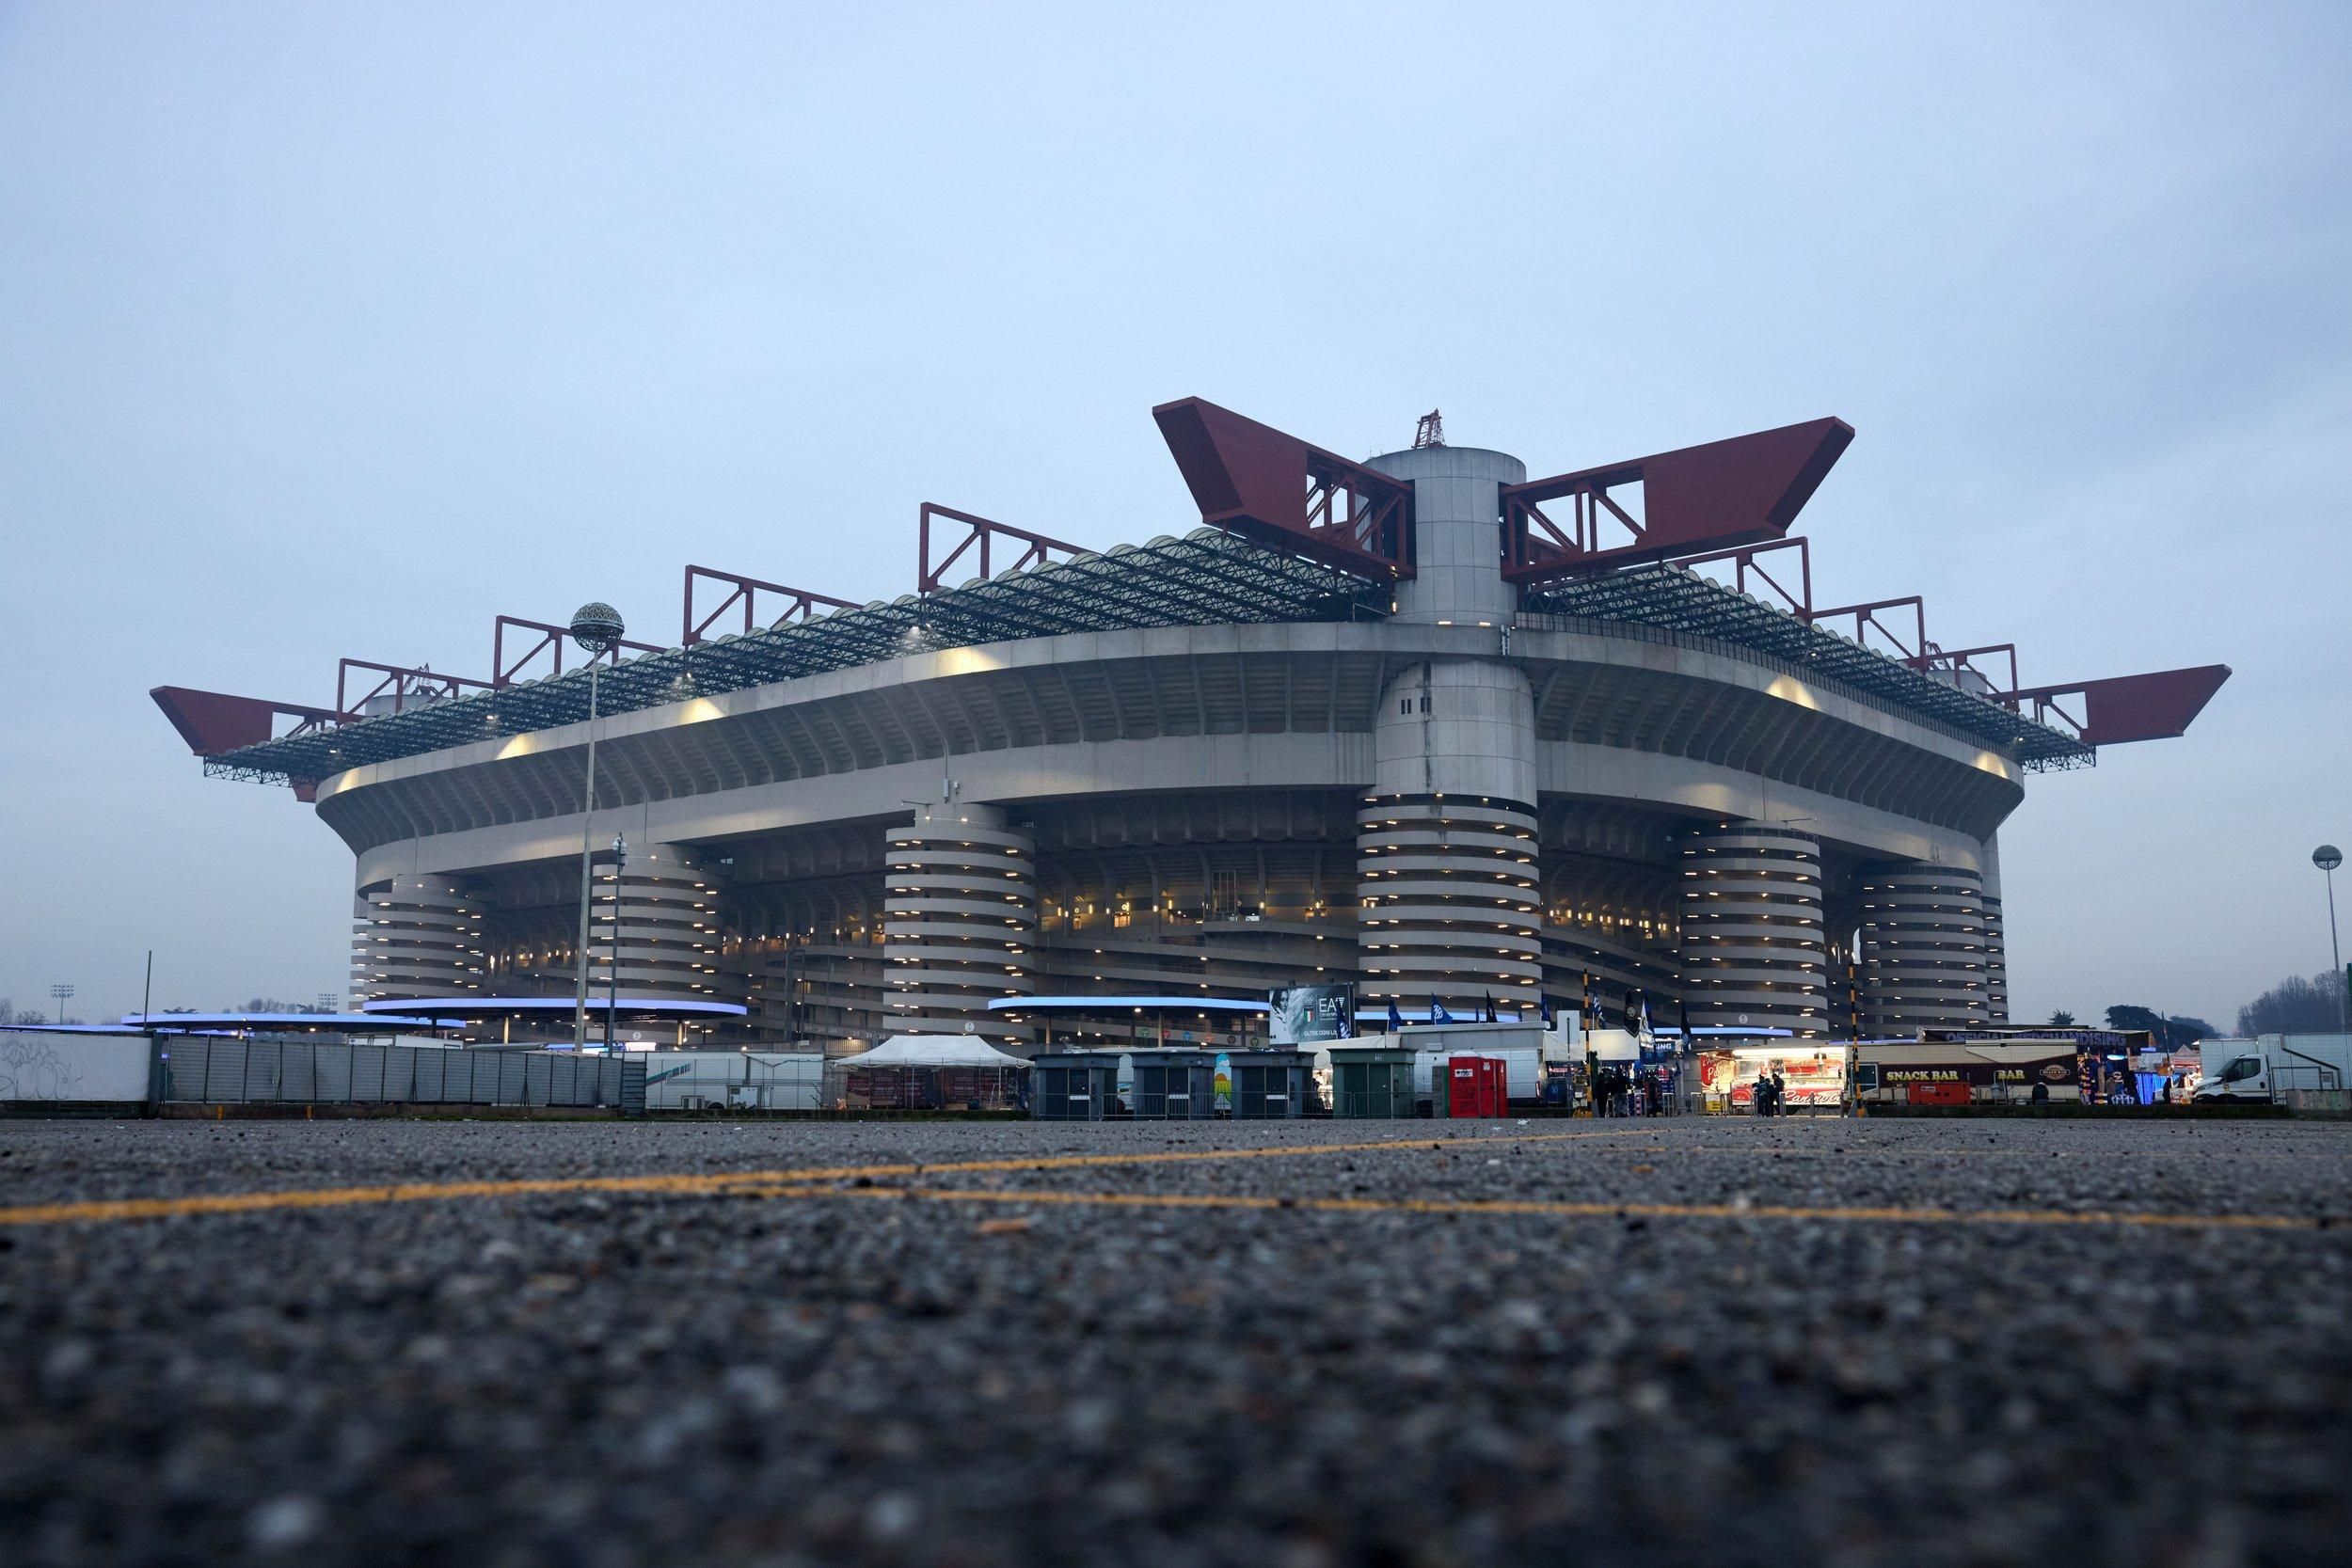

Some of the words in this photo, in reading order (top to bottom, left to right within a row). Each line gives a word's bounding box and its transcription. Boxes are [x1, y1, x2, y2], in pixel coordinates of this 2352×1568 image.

[1886, 1070, 1929, 1081] SNACK
[1931, 1070, 1959, 1081] BAR
[1997, 1069, 2026, 1080] BAR
